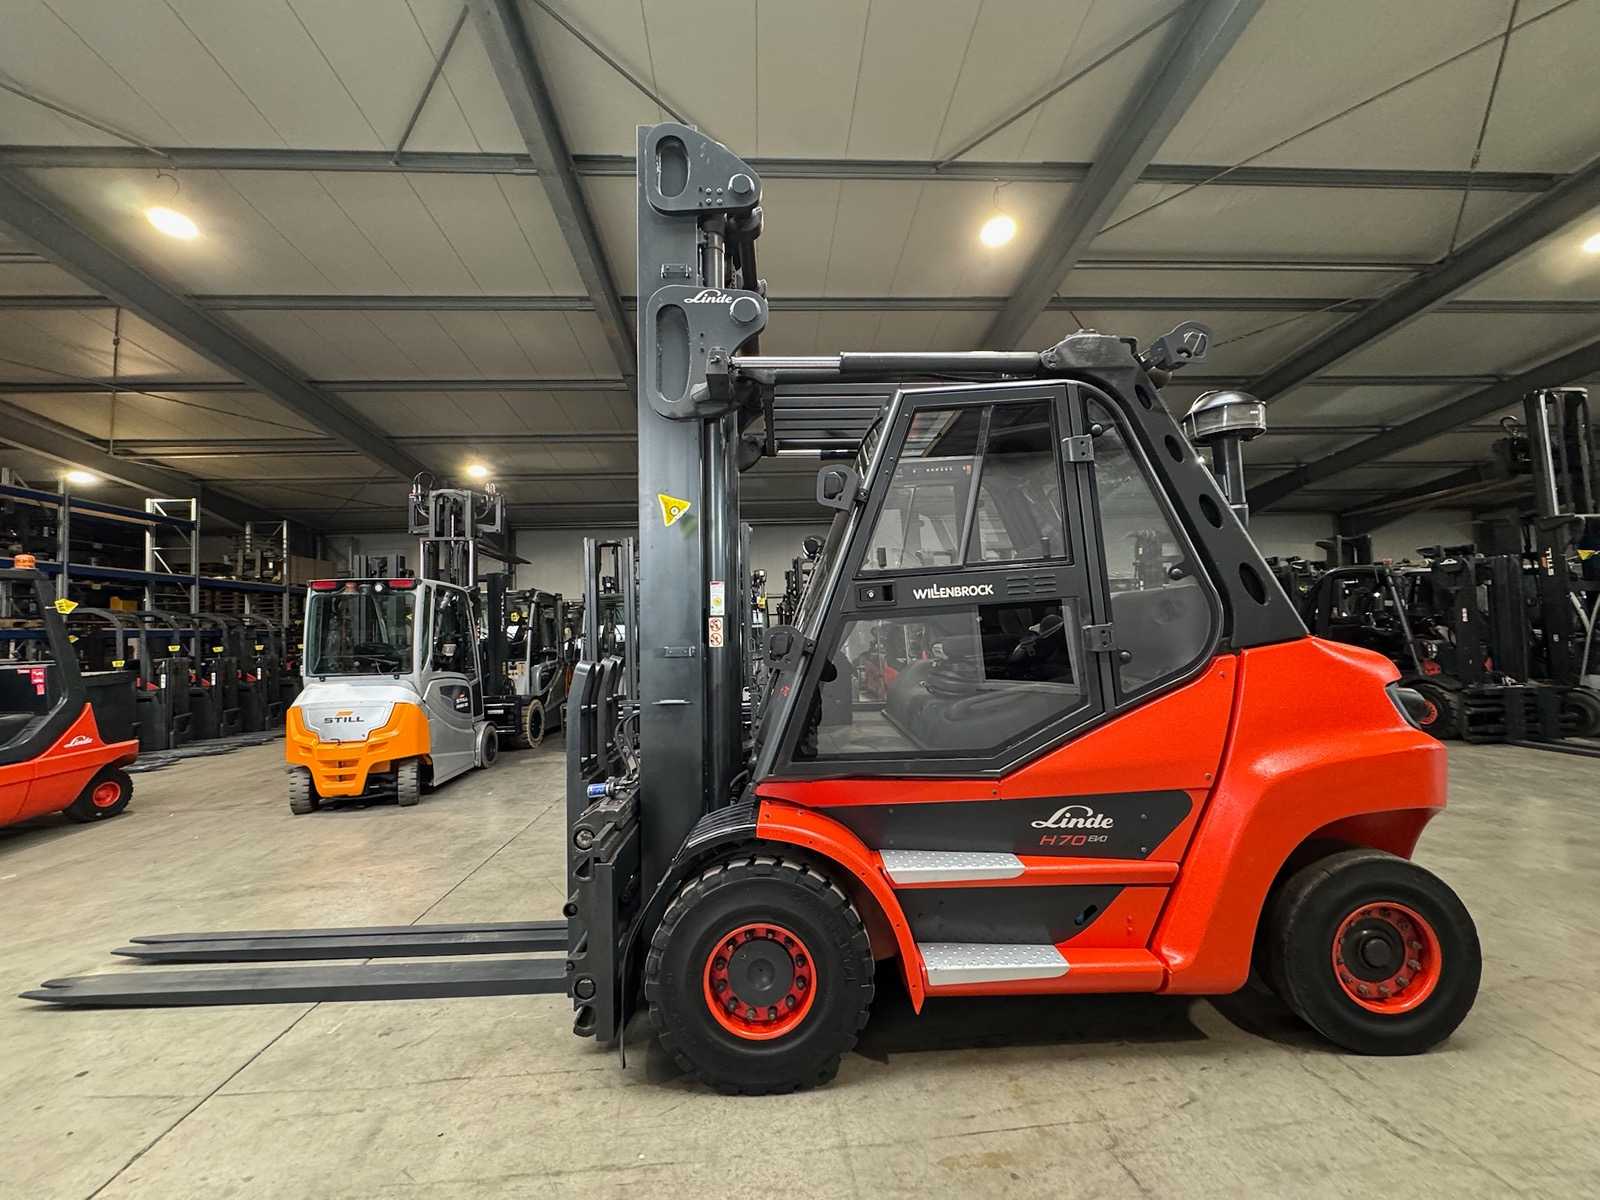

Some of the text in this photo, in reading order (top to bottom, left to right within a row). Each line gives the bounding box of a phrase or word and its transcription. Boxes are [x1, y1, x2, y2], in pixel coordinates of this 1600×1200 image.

[684, 289, 733, 303] Linde
[913, 584, 994, 600] WILLENBROCK
[1031, 805, 1113, 829] Linde
[1040, 835, 1108, 846] H70 EVO
